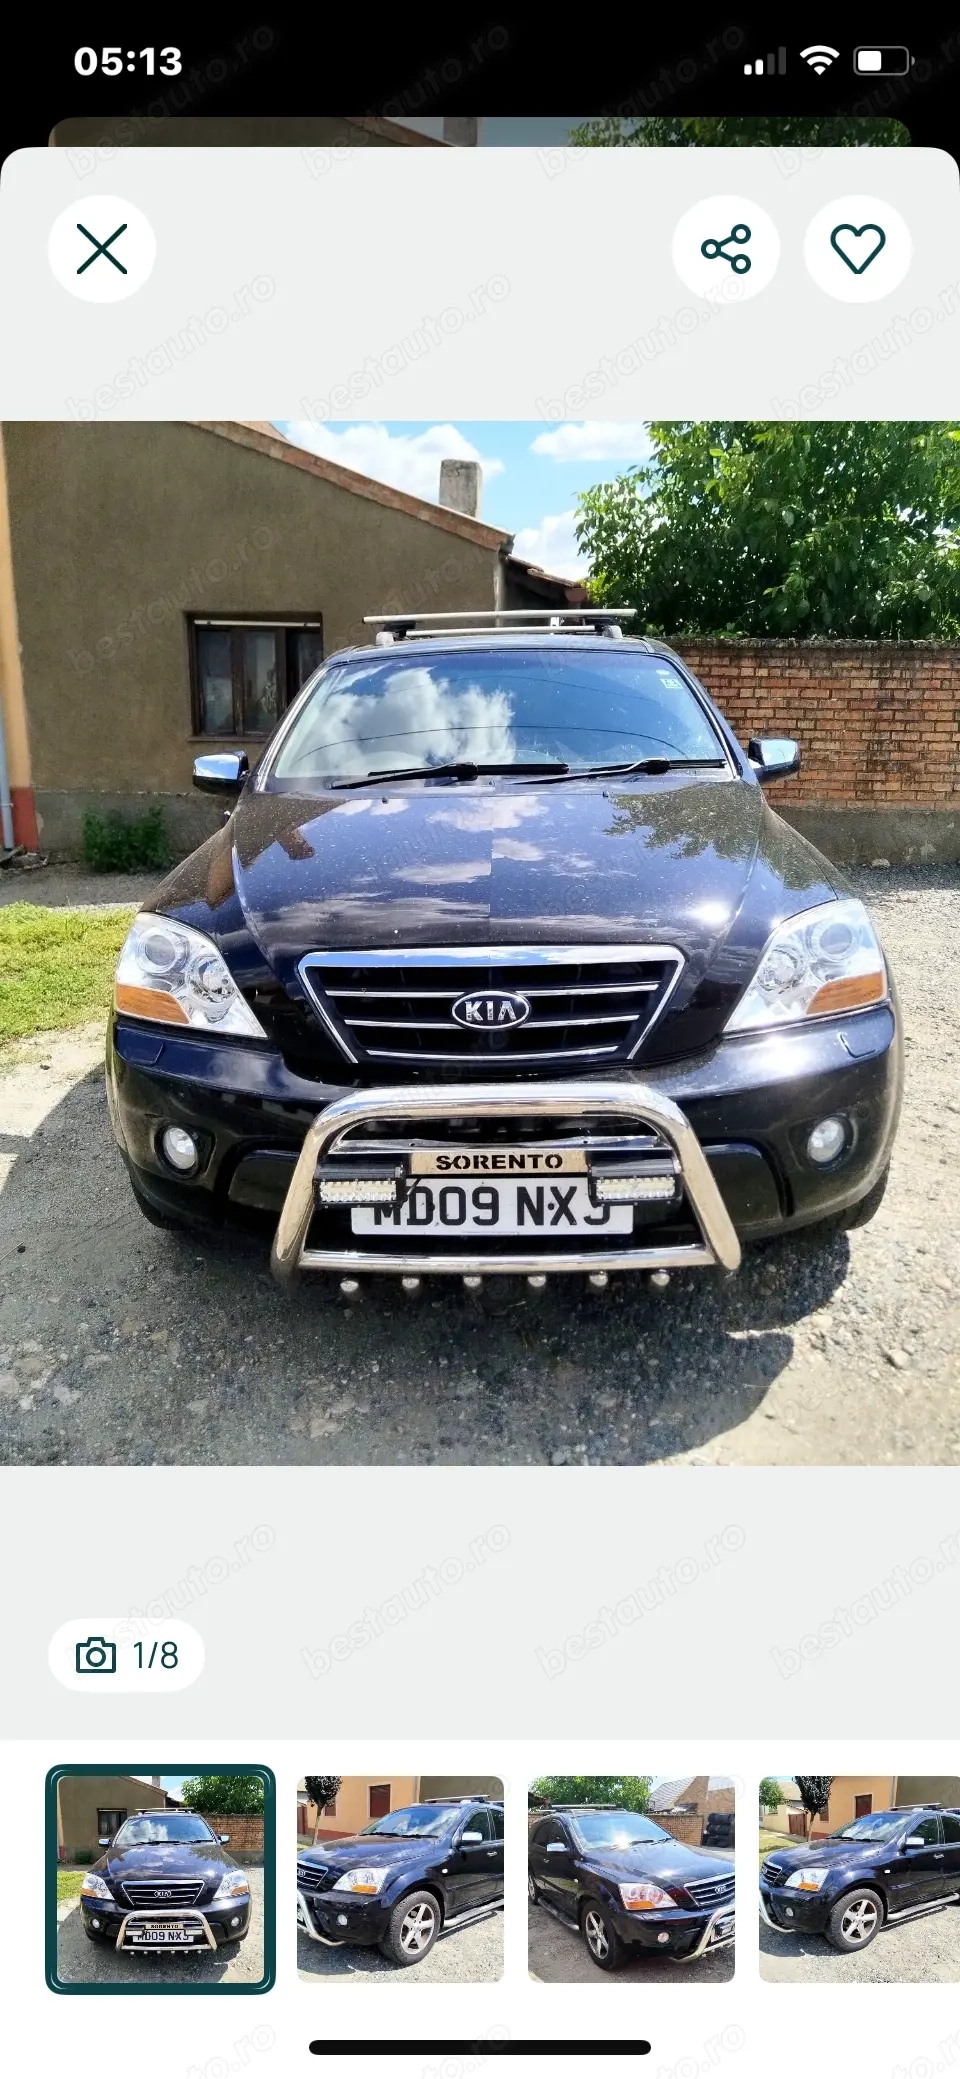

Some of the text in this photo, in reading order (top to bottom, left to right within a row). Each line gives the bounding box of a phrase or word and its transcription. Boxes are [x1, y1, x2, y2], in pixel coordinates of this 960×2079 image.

[74, 46, 182, 76] 05:13
[464, 1000, 517, 1022] KIA
[435, 1153, 563, 1171] SORENTO
[133, 1641, 179, 1669] 1/8
